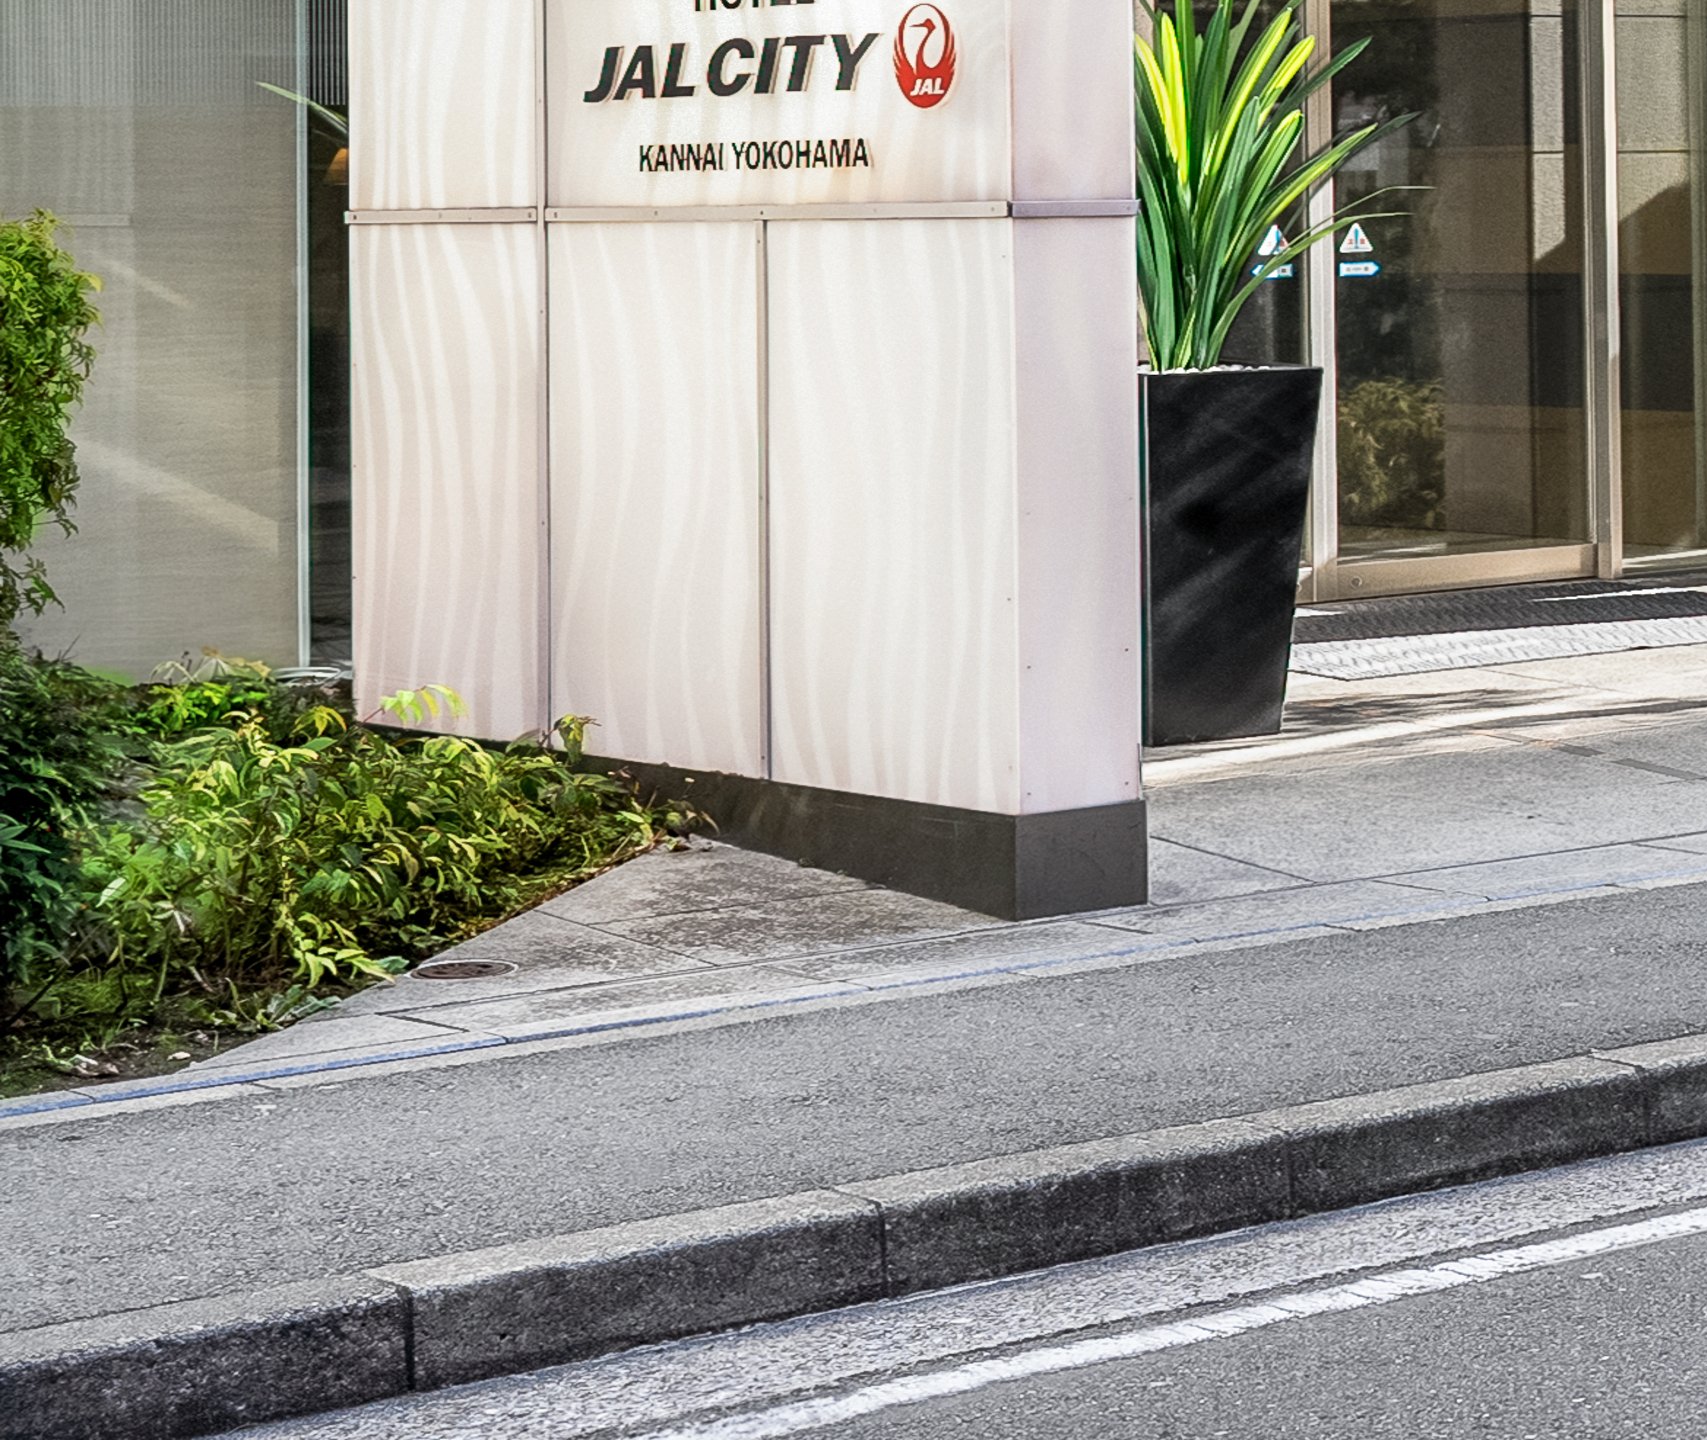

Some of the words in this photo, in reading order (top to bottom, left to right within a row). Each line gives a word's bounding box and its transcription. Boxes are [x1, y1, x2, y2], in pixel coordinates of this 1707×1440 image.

[910, 77, 945, 96] JAL
[639, 143, 725, 173] KANNAI
[731, 138, 870, 170] YOKOHAMA
